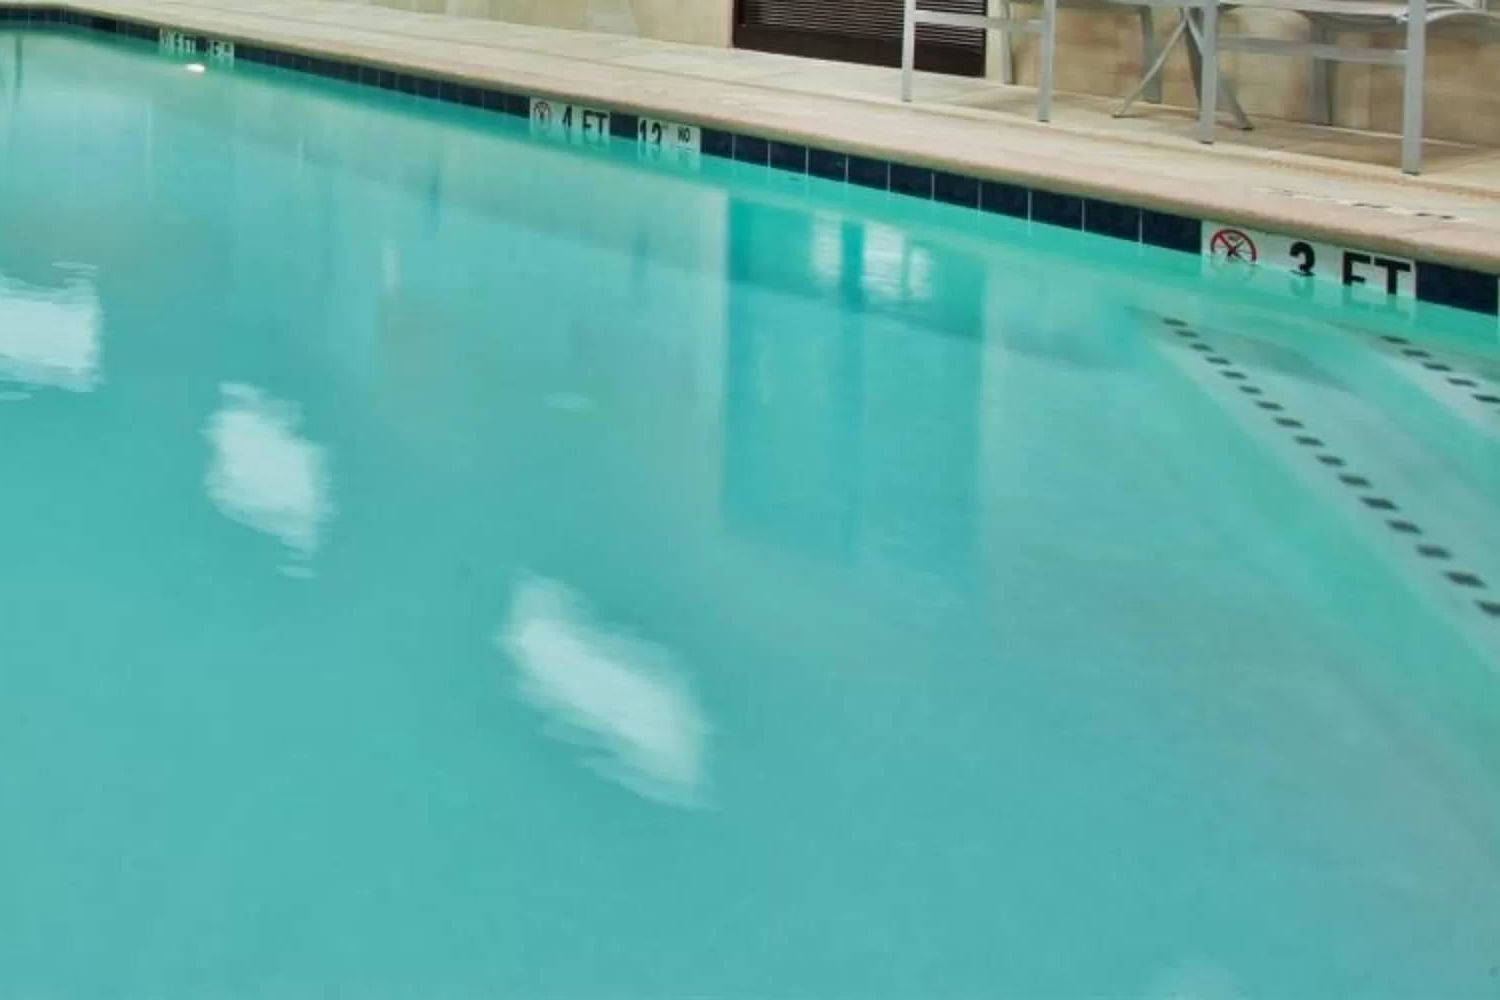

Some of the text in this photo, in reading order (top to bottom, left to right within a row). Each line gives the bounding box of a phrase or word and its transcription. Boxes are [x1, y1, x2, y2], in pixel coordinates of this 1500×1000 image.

[583, 110, 608, 135] FT
[1289, 241, 1411, 295] 3 FT
